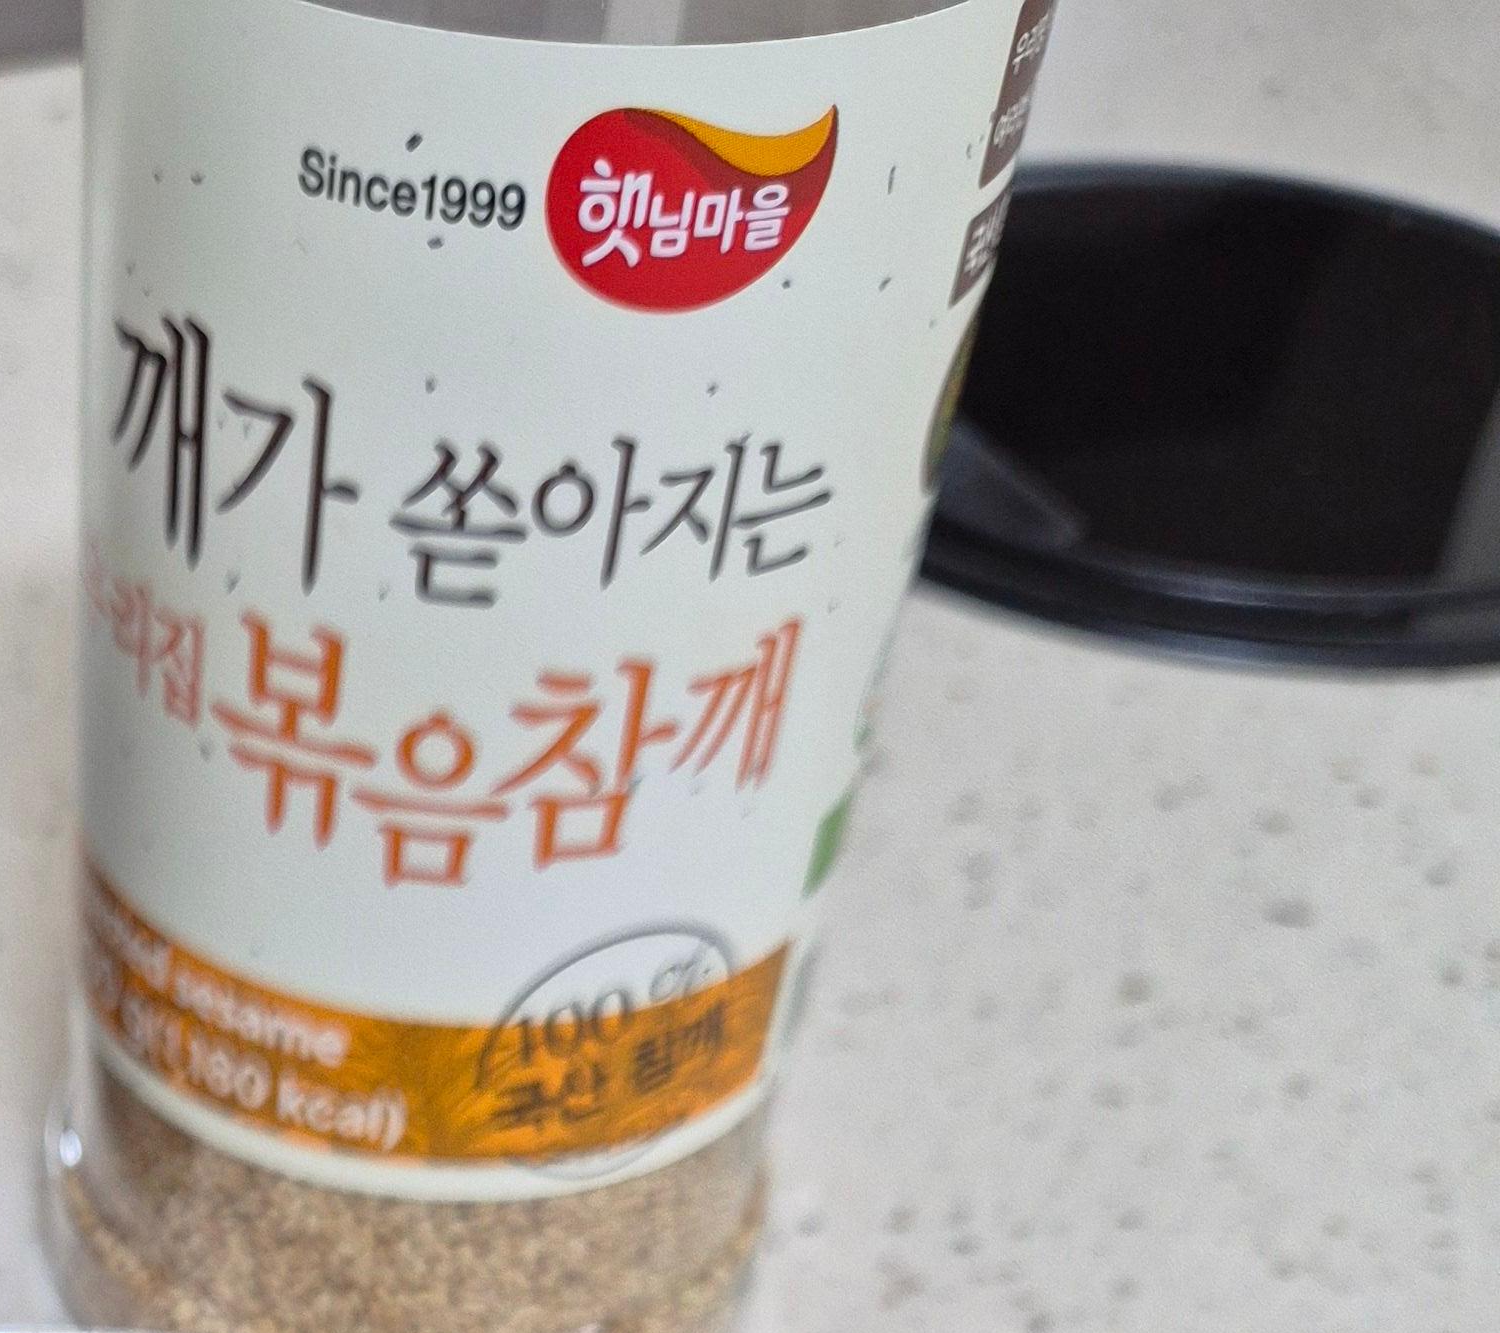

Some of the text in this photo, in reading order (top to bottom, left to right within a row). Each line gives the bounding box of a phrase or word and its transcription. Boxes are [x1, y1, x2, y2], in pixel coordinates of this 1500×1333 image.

[298, 146, 527, 232] Since1999
[578, 158, 792, 269] 햇님마을
[112, 314, 833, 609] 깨가 쏟아지는
[211, 614, 805, 887] 볶음참깨
